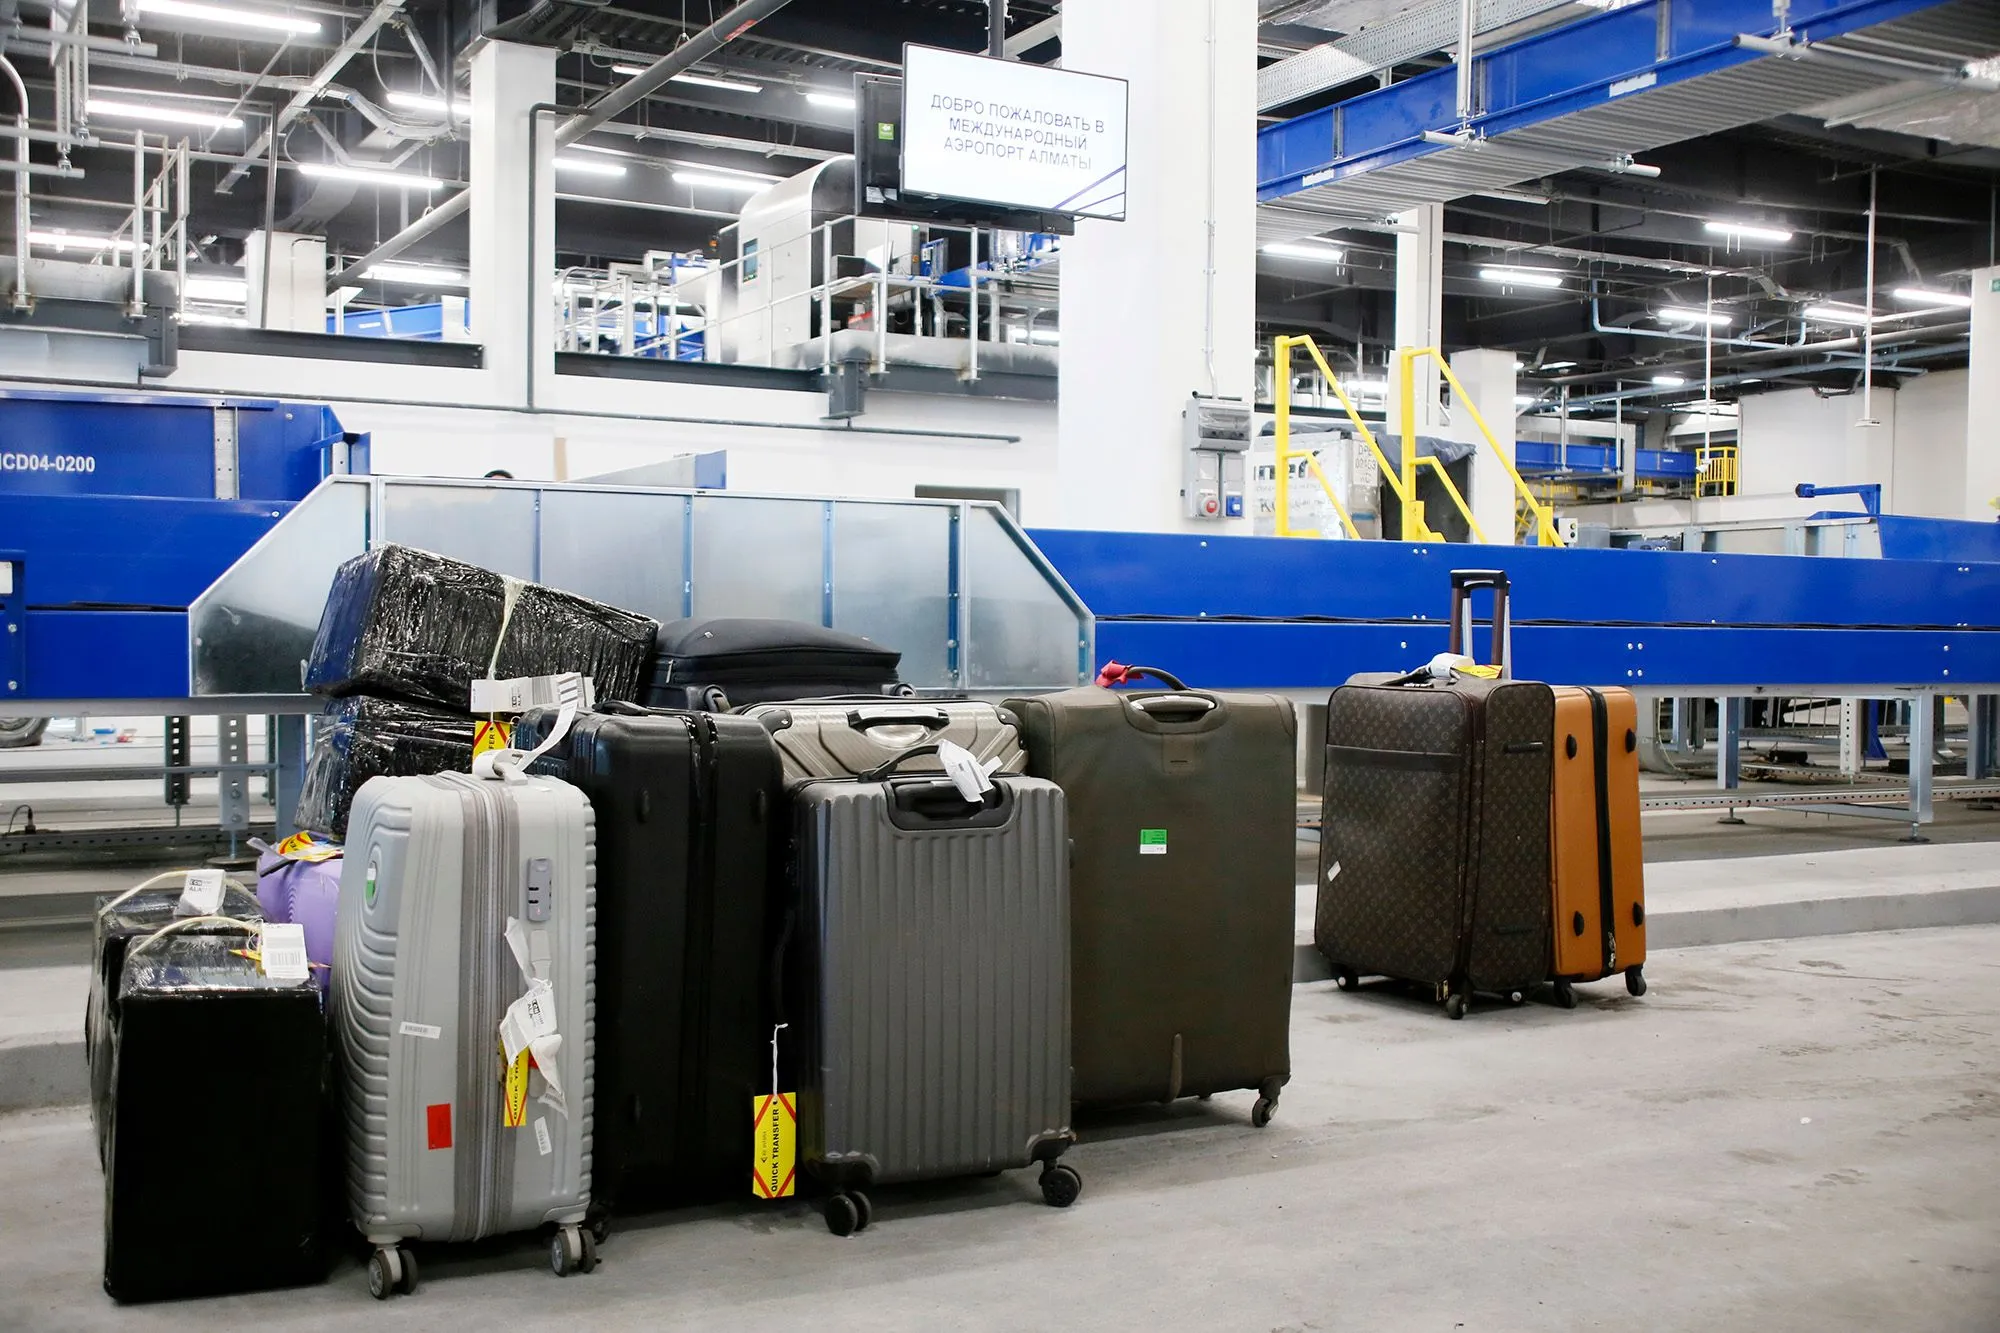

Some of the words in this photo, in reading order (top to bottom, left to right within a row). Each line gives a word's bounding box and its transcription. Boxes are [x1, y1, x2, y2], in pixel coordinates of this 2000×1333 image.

[930, 94, 985, 115] ДОБРО
[989, 103, 1091, 132] ПОЖАЛОВАТЬ
[1095, 119, 1105, 134] В
[949, 117, 1087, 150] МЕЖДУНАРОДНЫЙ
[943, 136, 1024, 161] АЭРОПОРТ
[1028, 149, 1092, 170] АЛМАТЫ
[0, 453, 96, 472] CD04-0200
[772, 1108, 780, 1159] TRANSFER
[771, 1162, 779, 1192] QUICK
